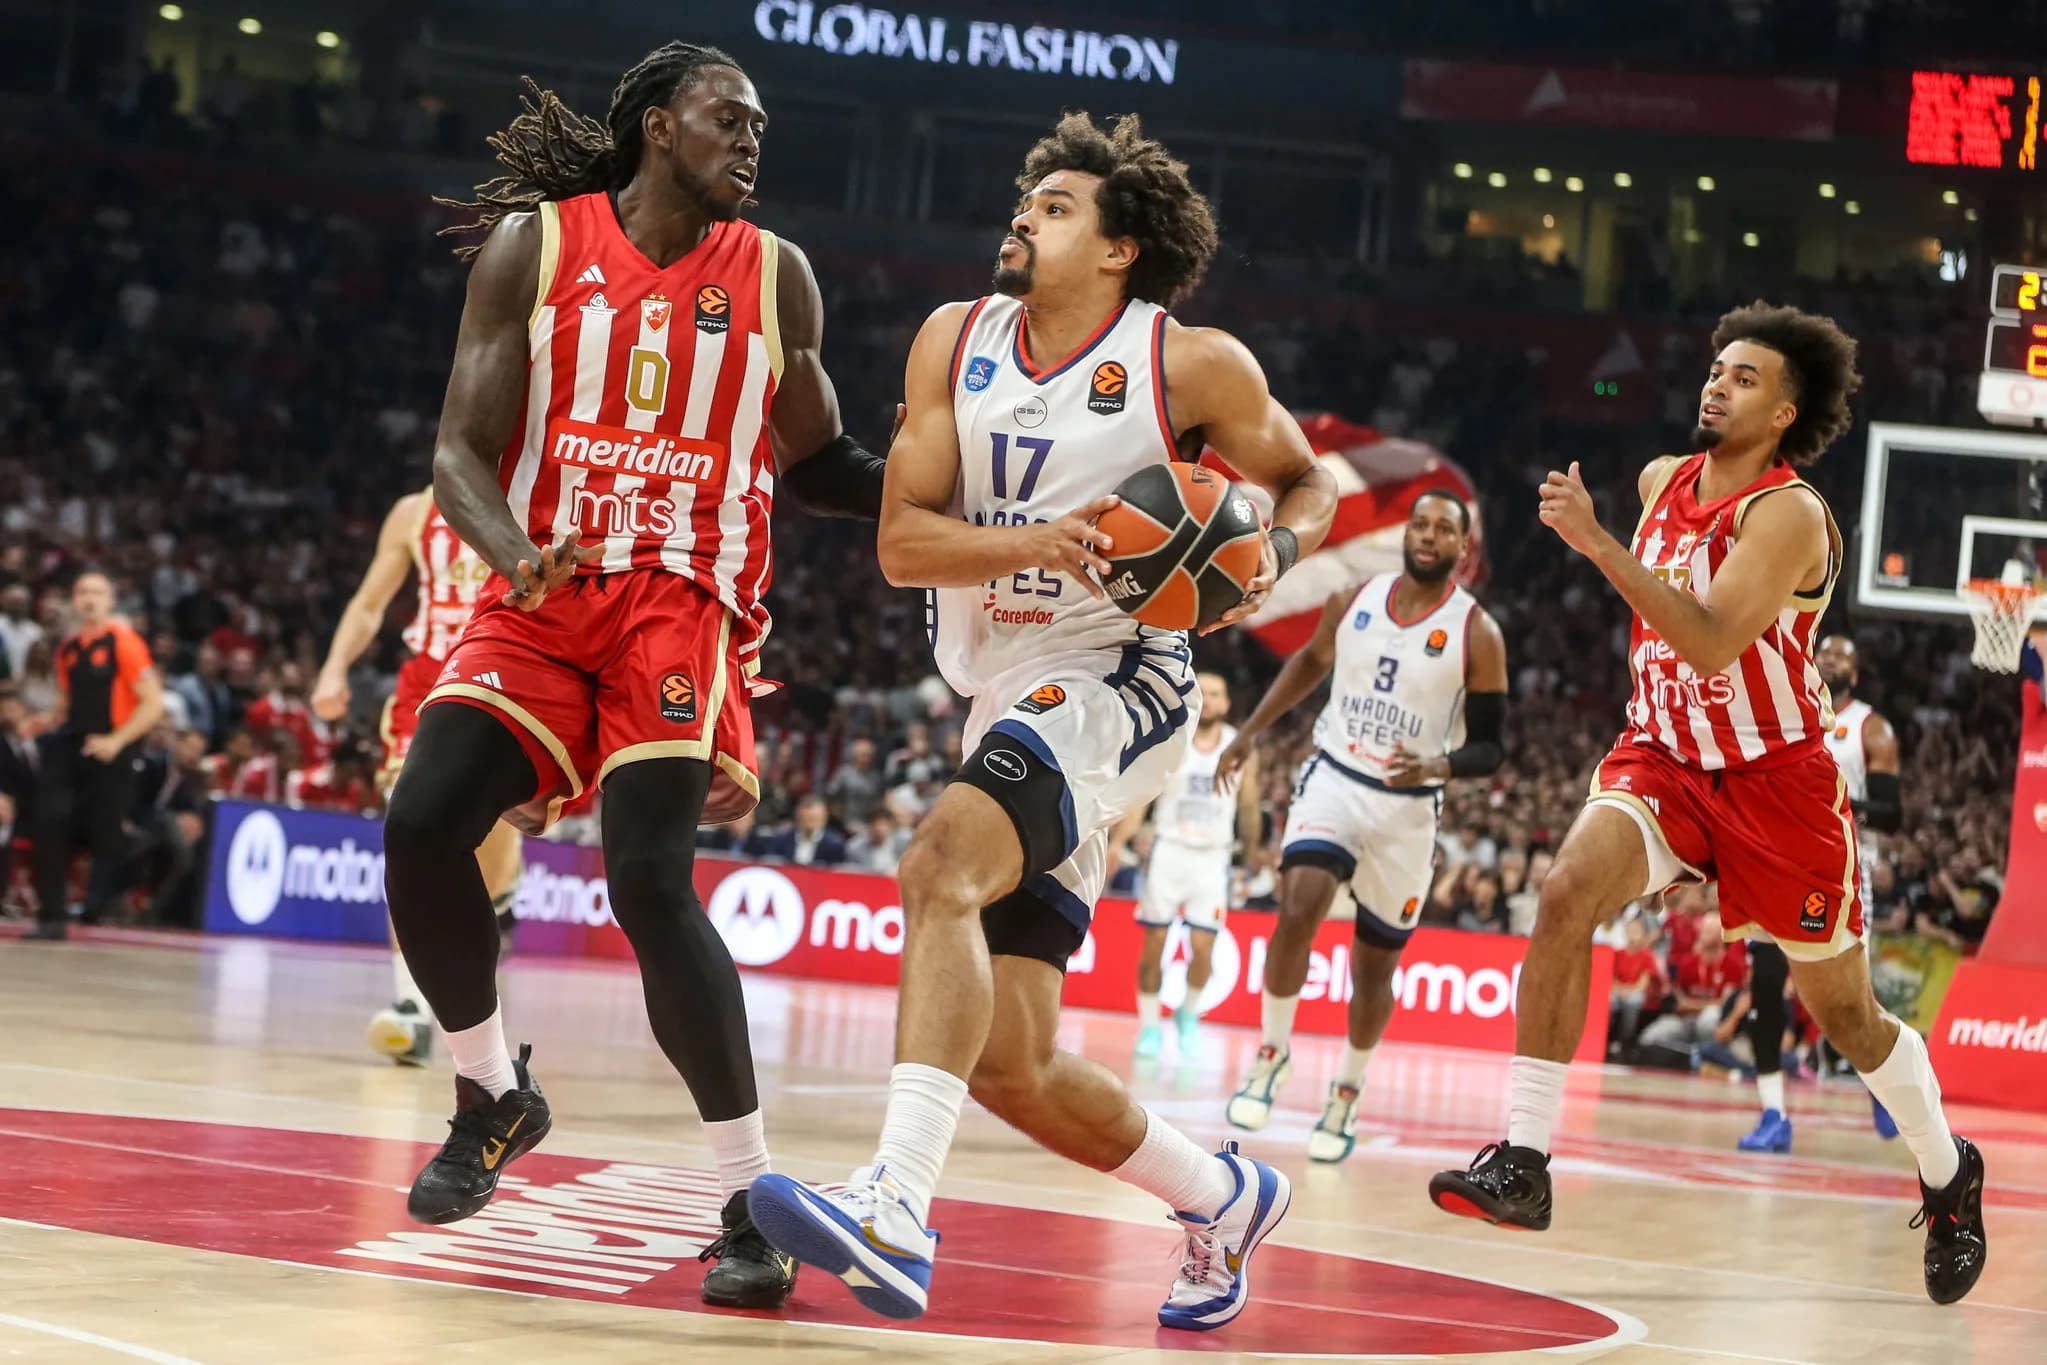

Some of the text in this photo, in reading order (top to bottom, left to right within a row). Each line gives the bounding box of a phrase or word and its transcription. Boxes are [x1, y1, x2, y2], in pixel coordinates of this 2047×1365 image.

[754, 0, 1179, 85] GLOBAL FASHION
[696, 320, 728, 329] ETIHAD
[625, 345, 671, 415] 0
[1089, 400, 1122, 410] ETIHAD
[553, 430, 715, 481] meridian
[989, 431, 1055, 502] 17
[569, 486, 678, 536] mts
[992, 606, 1054, 625] corendon
[1374, 655, 1399, 693] 3
[1658, 672, 1736, 709] mts
[1342, 695, 1423, 738] ANADOLU
